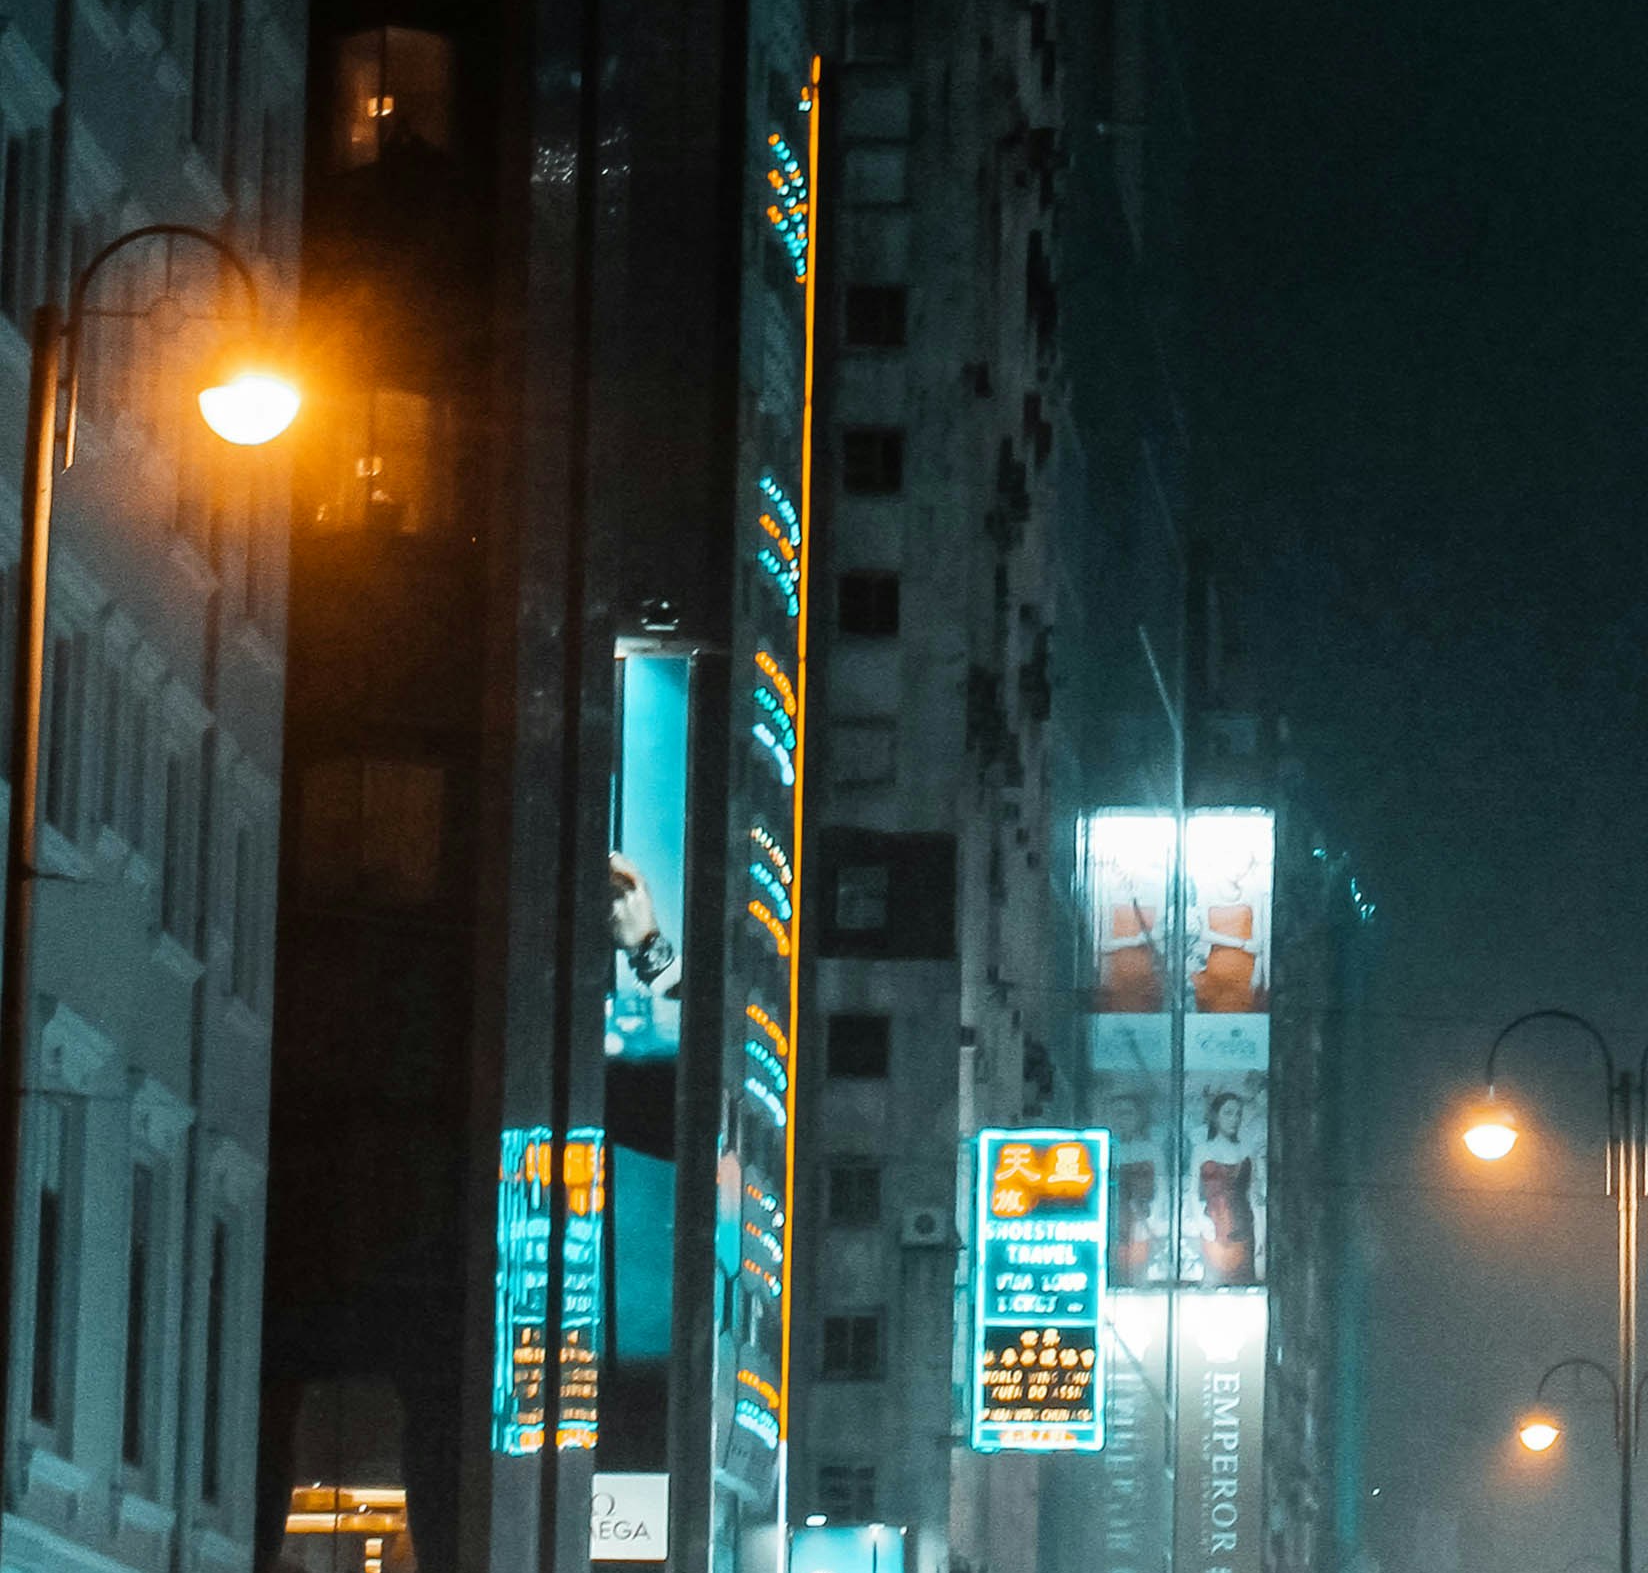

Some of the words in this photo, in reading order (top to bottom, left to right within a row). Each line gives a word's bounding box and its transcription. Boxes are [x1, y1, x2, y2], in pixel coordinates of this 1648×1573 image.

[1006, 1244, 1077, 1265] TRAVEL
[1211, 1372, 1241, 1556] EMPEROR
[592, 1520, 652, 1541] EGA
